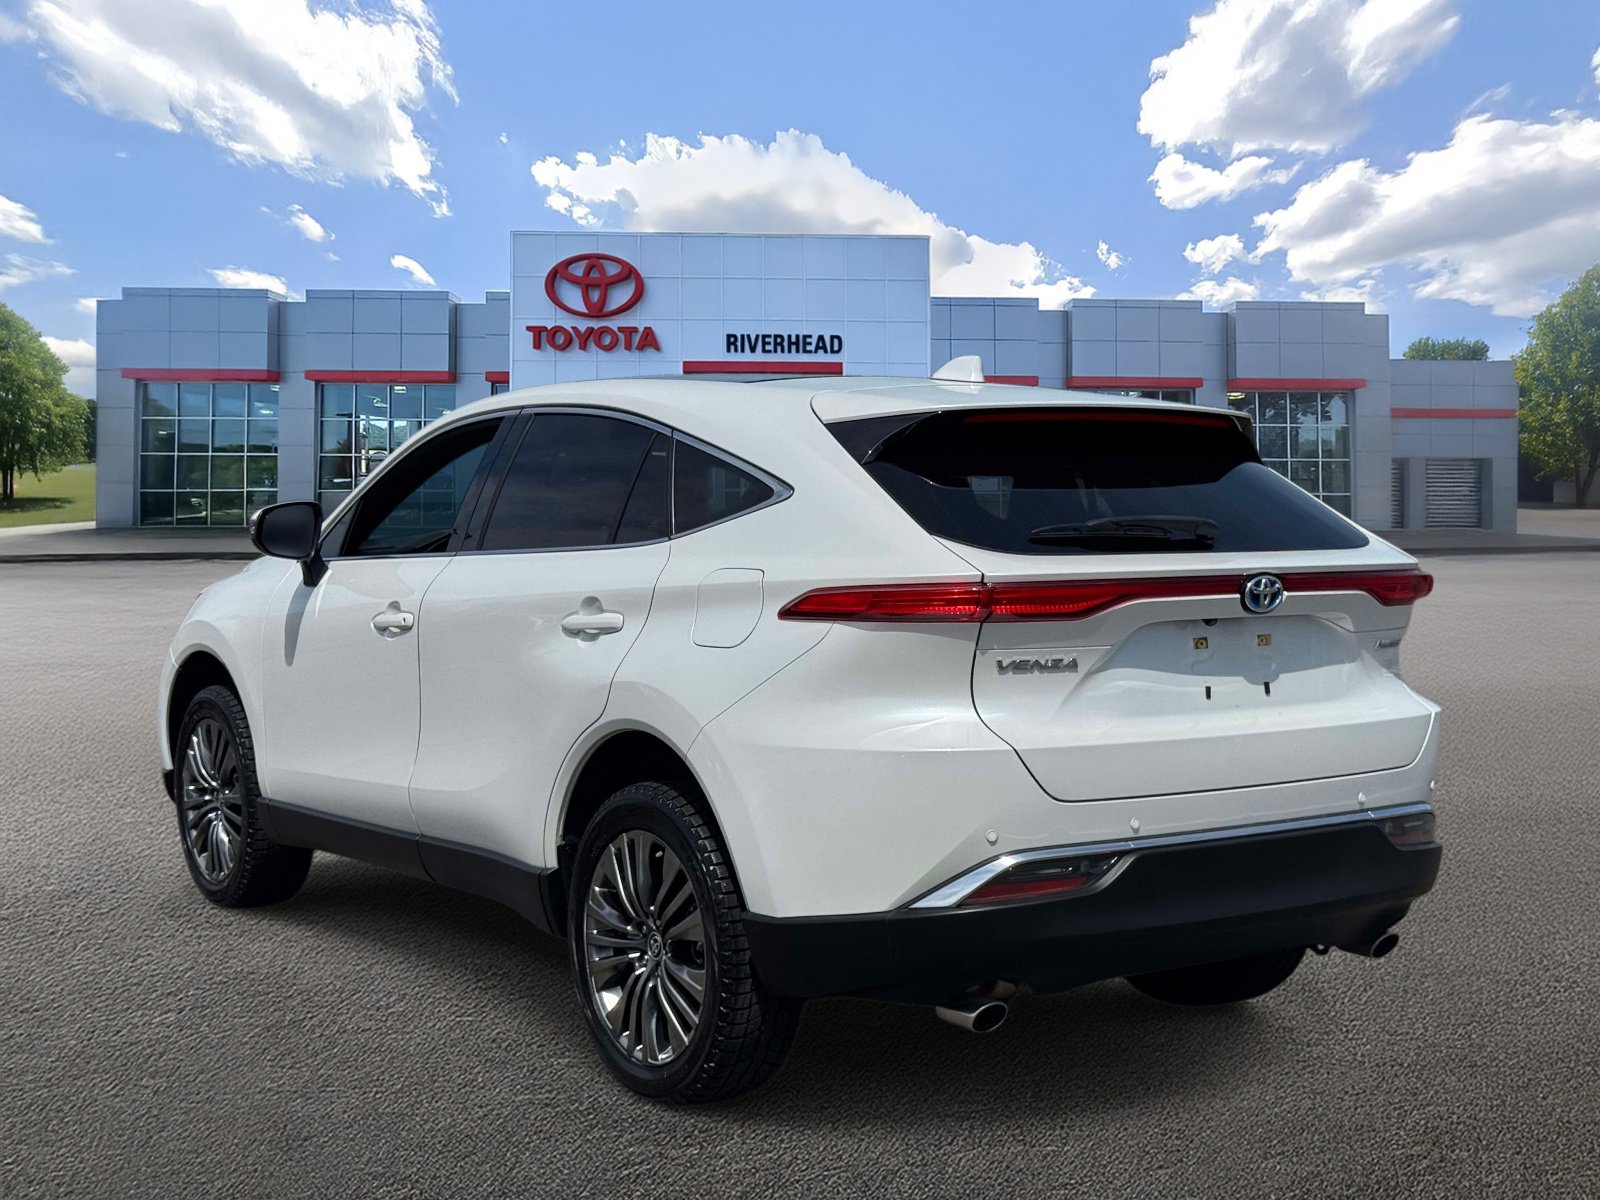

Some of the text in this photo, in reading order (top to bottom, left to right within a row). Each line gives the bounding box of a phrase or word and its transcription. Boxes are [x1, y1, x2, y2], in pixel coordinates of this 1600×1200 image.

[525, 325, 661, 352] TOYOTA
[726, 333, 843, 354] RIVERHEAD
[996, 656, 1079, 675] VENZA
